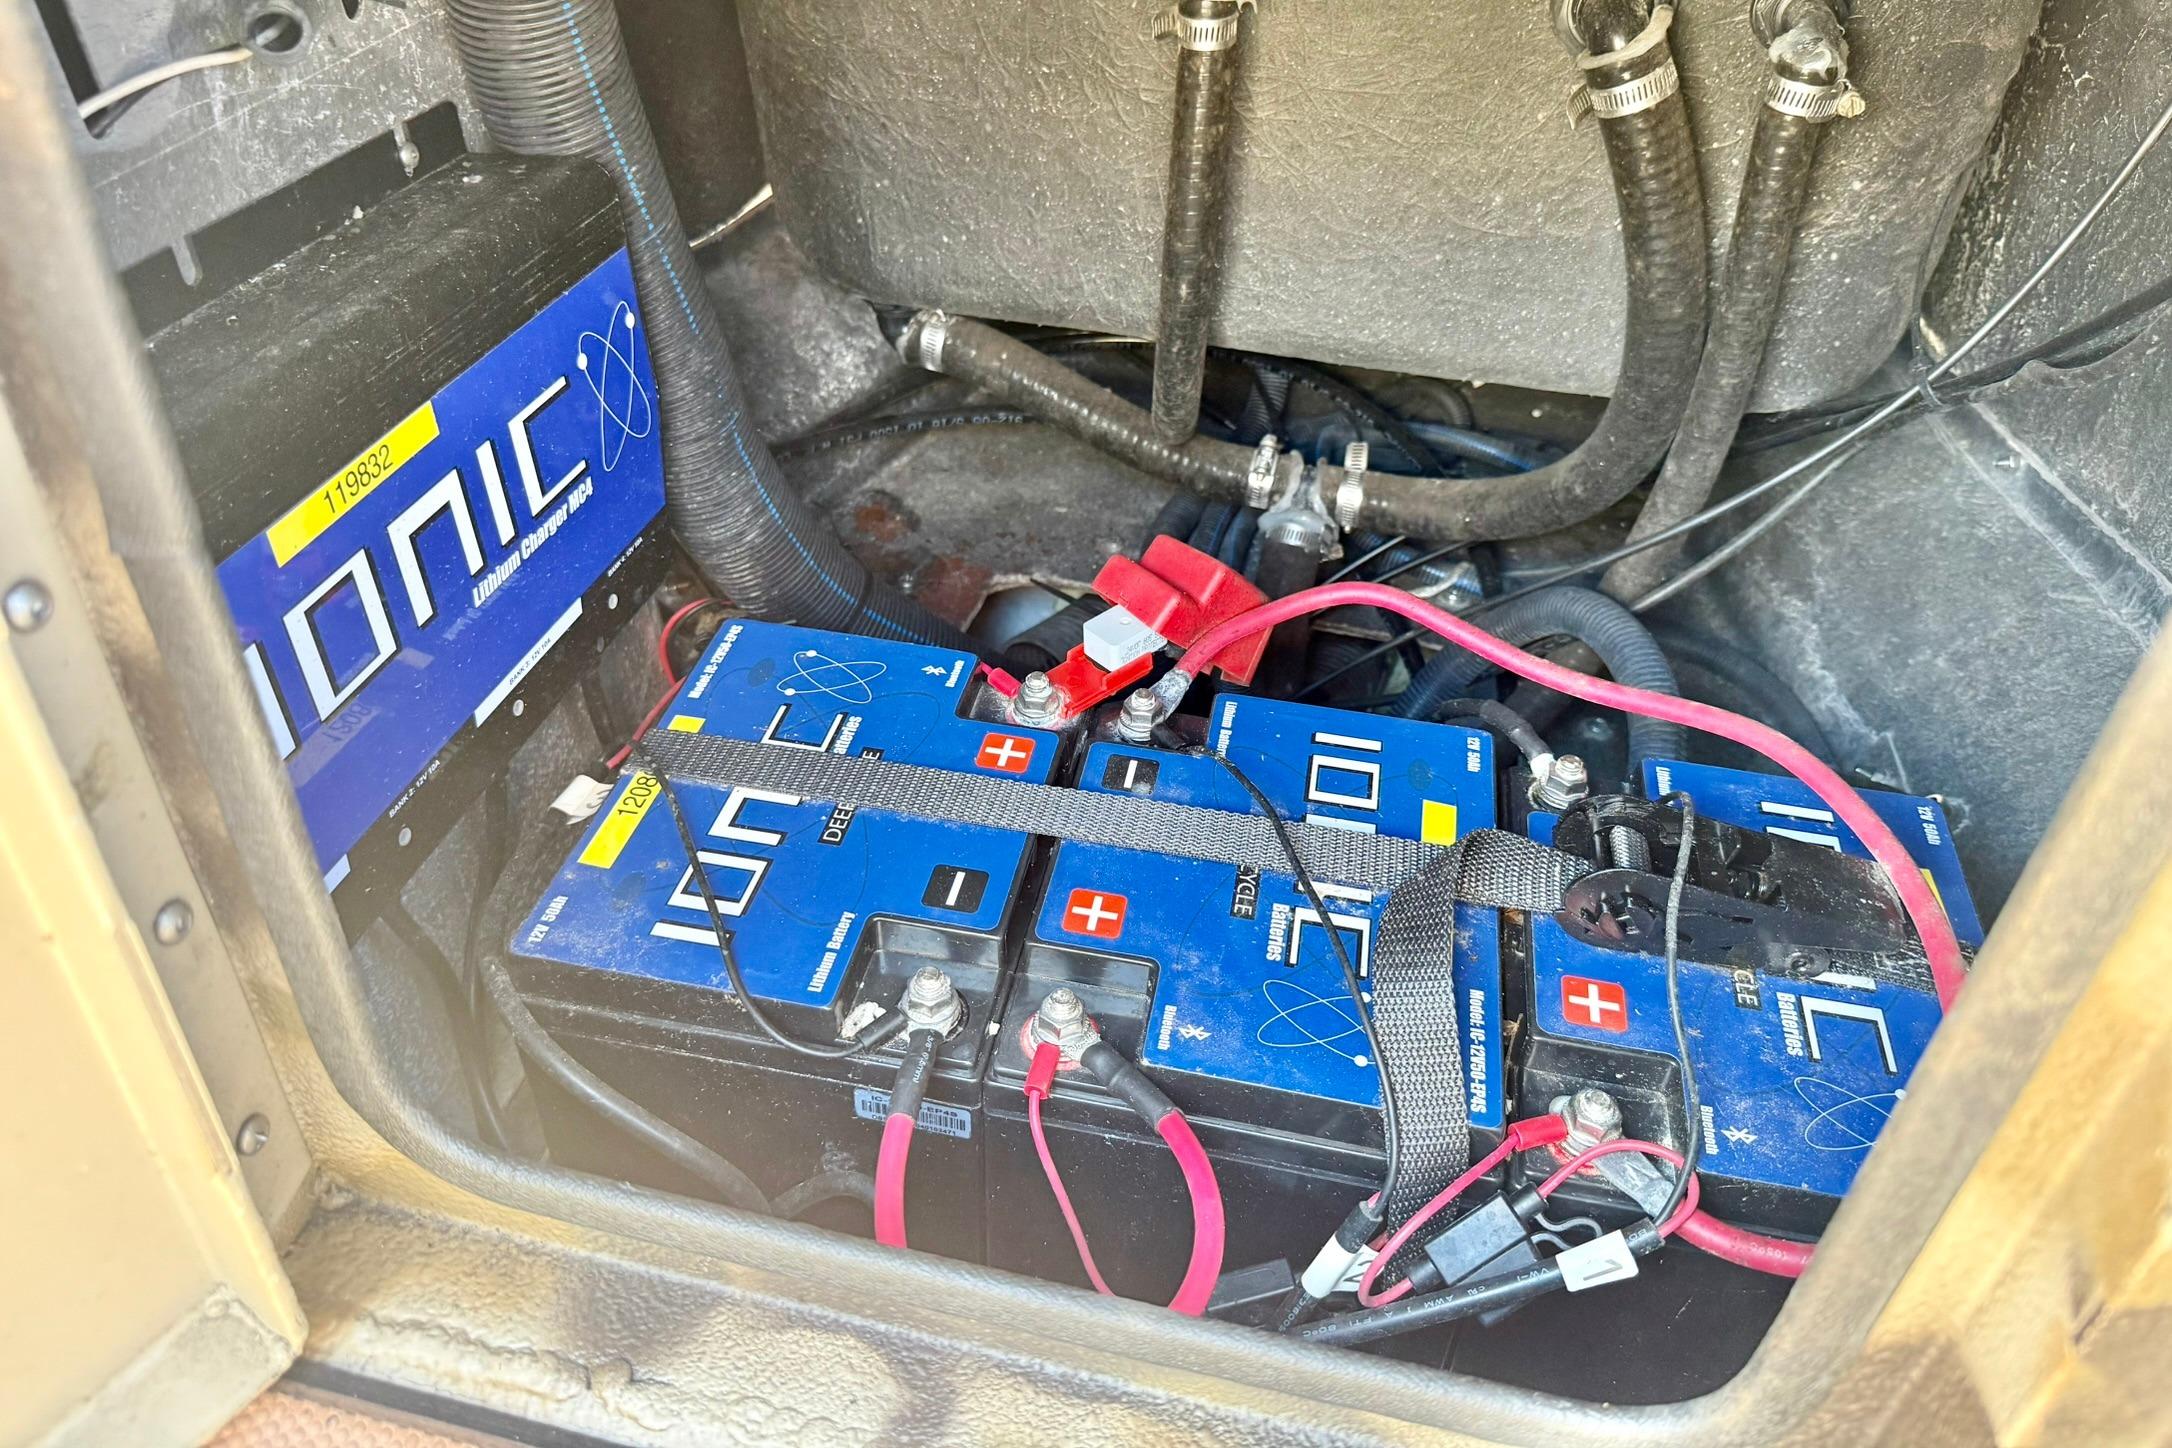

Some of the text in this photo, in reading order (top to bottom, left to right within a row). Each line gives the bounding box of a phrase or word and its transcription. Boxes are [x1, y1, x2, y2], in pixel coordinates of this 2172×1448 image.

[323, 444, 394, 514] 119832
[472, 476, 594, 609] Lithium Charger MC4
[687, 672, 713, 699] Model:
[833, 715, 863, 755] atteries
[1221, 701, 1239, 728] Lithium
[1466, 736, 1481, 772] 12V 50Ah
[388, 794, 409, 818] BANK
[415, 772, 429, 788] 12V
[427, 759, 441, 775] 10A
[1917, 806, 1941, 846] 12V 50Ah
[528, 896, 568, 948] 12V 50Ah
[1266, 903, 1290, 962] Batteries
[808, 911, 856, 993] Lithium Battery
[1157, 1004, 1177, 1050] Bluetooth
[1776, 991, 1803, 1057] Batteries
[1469, 988, 1487, 1114] Model: IC-12V50-EP4S
[1700, 1105, 1719, 1155] Bluetooth
[1424, 1295, 1455, 1310] AWM
